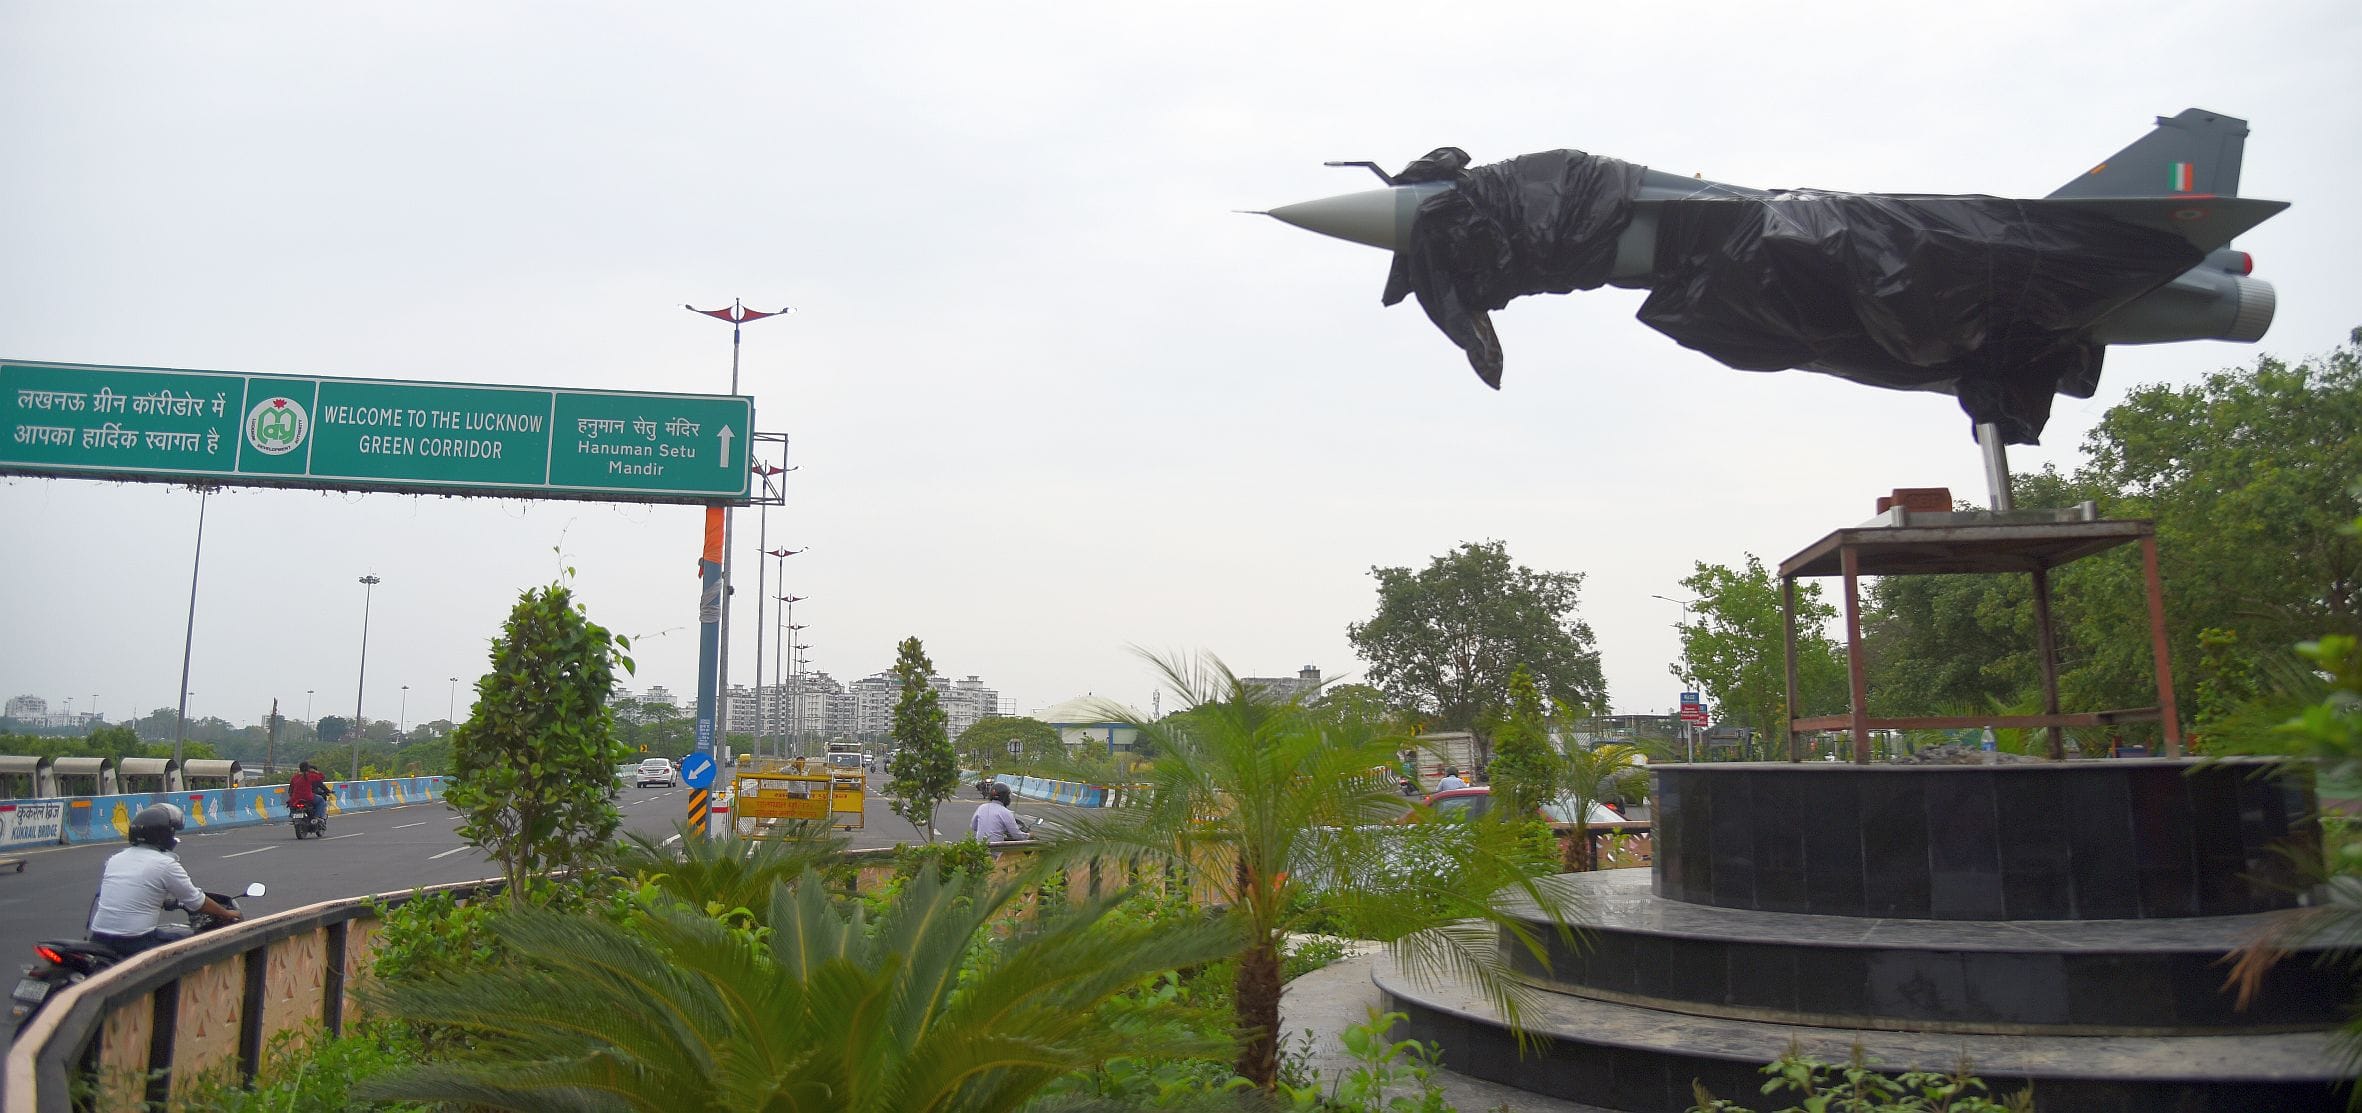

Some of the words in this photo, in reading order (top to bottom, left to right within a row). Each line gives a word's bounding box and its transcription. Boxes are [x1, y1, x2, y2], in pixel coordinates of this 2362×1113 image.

[18, 390, 88, 412] लखनऊ
[93, 386, 128, 414] ग्रीन
[132, 389, 206, 418] कॉरीडोर
[211, 391, 226, 418] में
[324, 405, 403, 427] WELCOME
[407, 409, 428, 429] TO
[431, 410, 461, 430] THE
[465, 412, 543, 434] LUCKNOW
[578, 418, 626, 440] हनुमान
[632, 416, 658, 441] सेतु
[664, 416, 702, 439] मंदिर
[14, 424, 76, 446] आपका
[82, 422, 140, 449] हार्दिक
[144, 431, 202, 452] स्वागत
[207, 427, 221, 455] है
[359, 434, 417, 456] GREEN
[420, 438, 503, 459] CORRIDOR
[578, 440, 653, 457] Hanuman
[659, 443, 696, 459] Setu
[608, 460, 664, 477] Mandir
